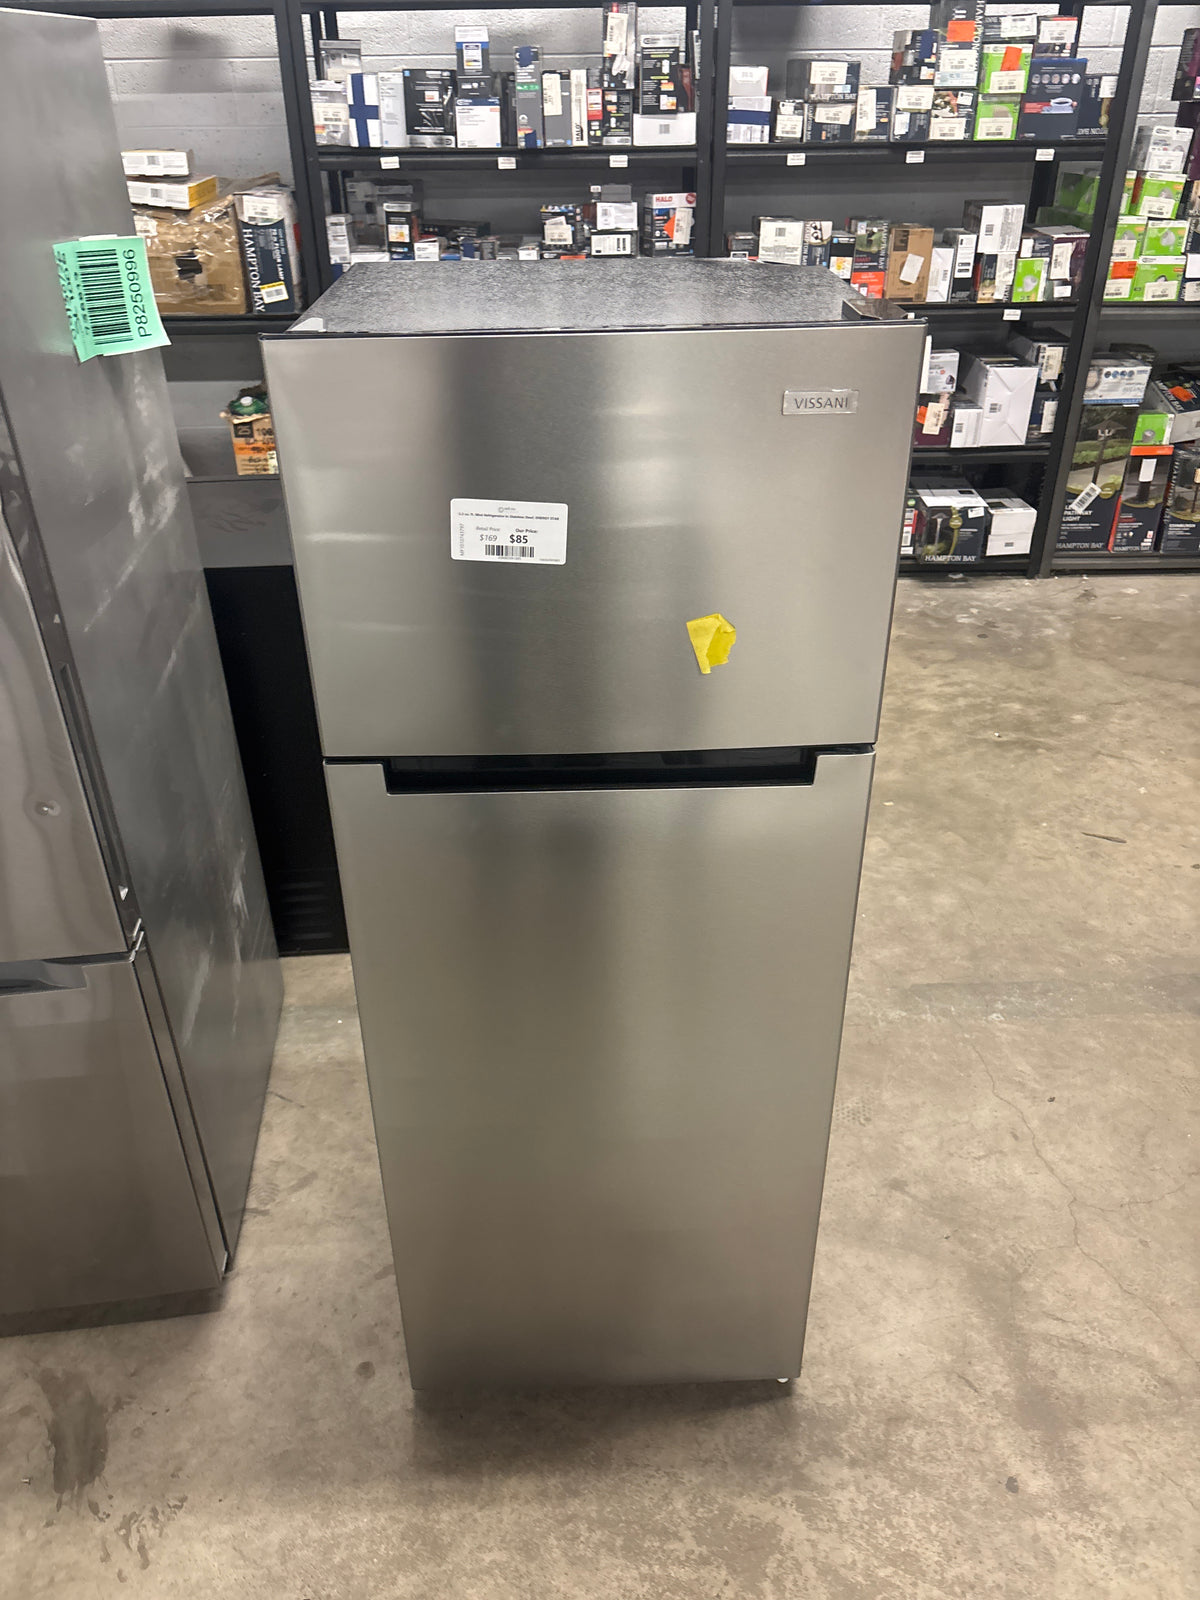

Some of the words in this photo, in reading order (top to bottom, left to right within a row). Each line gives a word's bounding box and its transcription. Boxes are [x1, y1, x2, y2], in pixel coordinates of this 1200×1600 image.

[655, 195, 673, 203] HALO
[242, 229, 260, 289] HAMPTON
[253, 291, 266, 312] BAY
[123, 249, 152, 338] P8250996
[794, 397, 848, 409] VISSANI
[509, 534, 528, 544] $85
